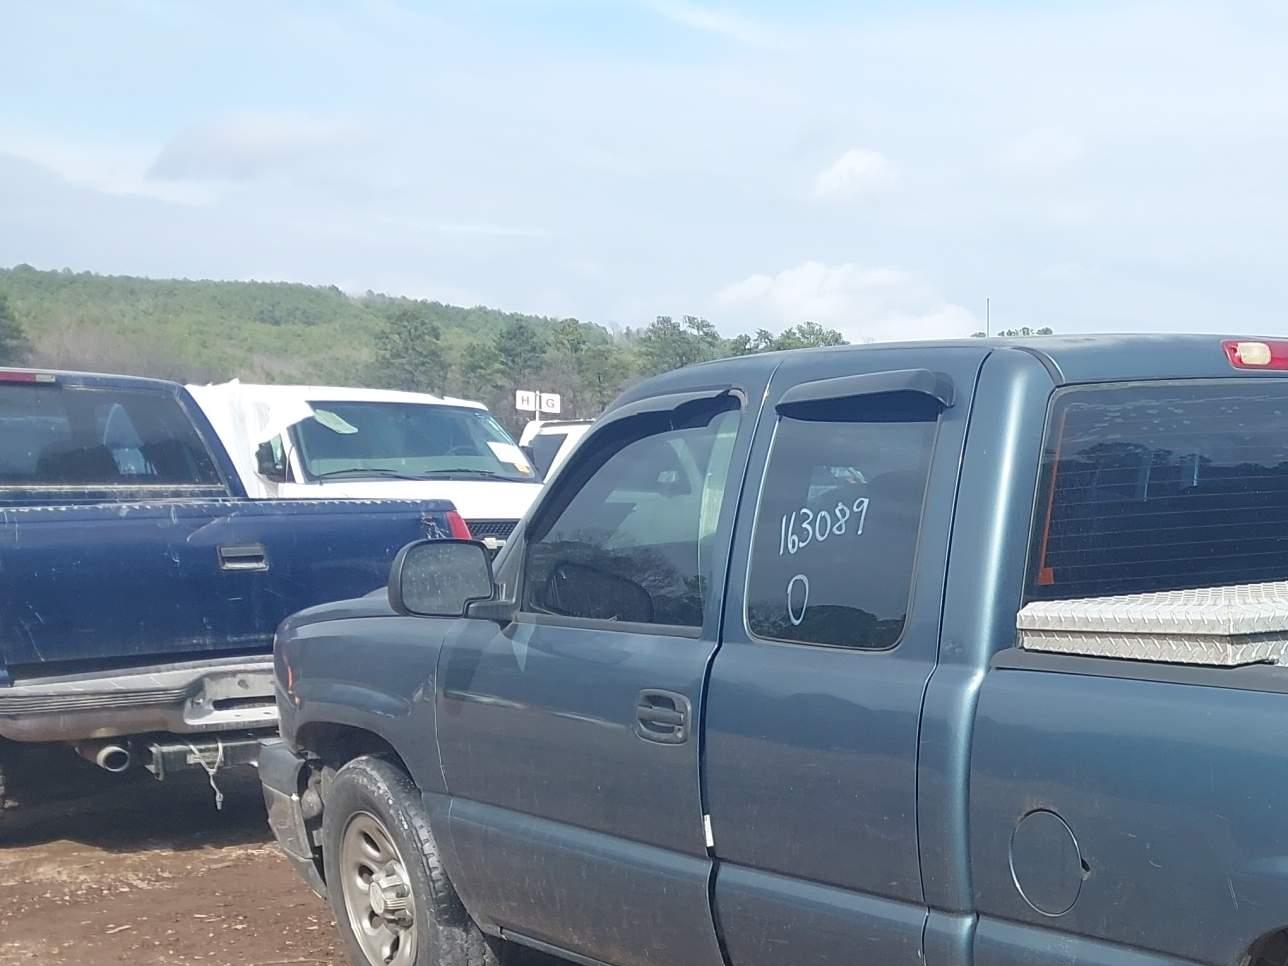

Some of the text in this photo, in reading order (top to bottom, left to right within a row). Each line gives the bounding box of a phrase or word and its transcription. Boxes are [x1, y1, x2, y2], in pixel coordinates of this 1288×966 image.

[521, 395, 530, 405] H
[545, 398, 555, 409] G
[779, 497, 870, 556] 163089
